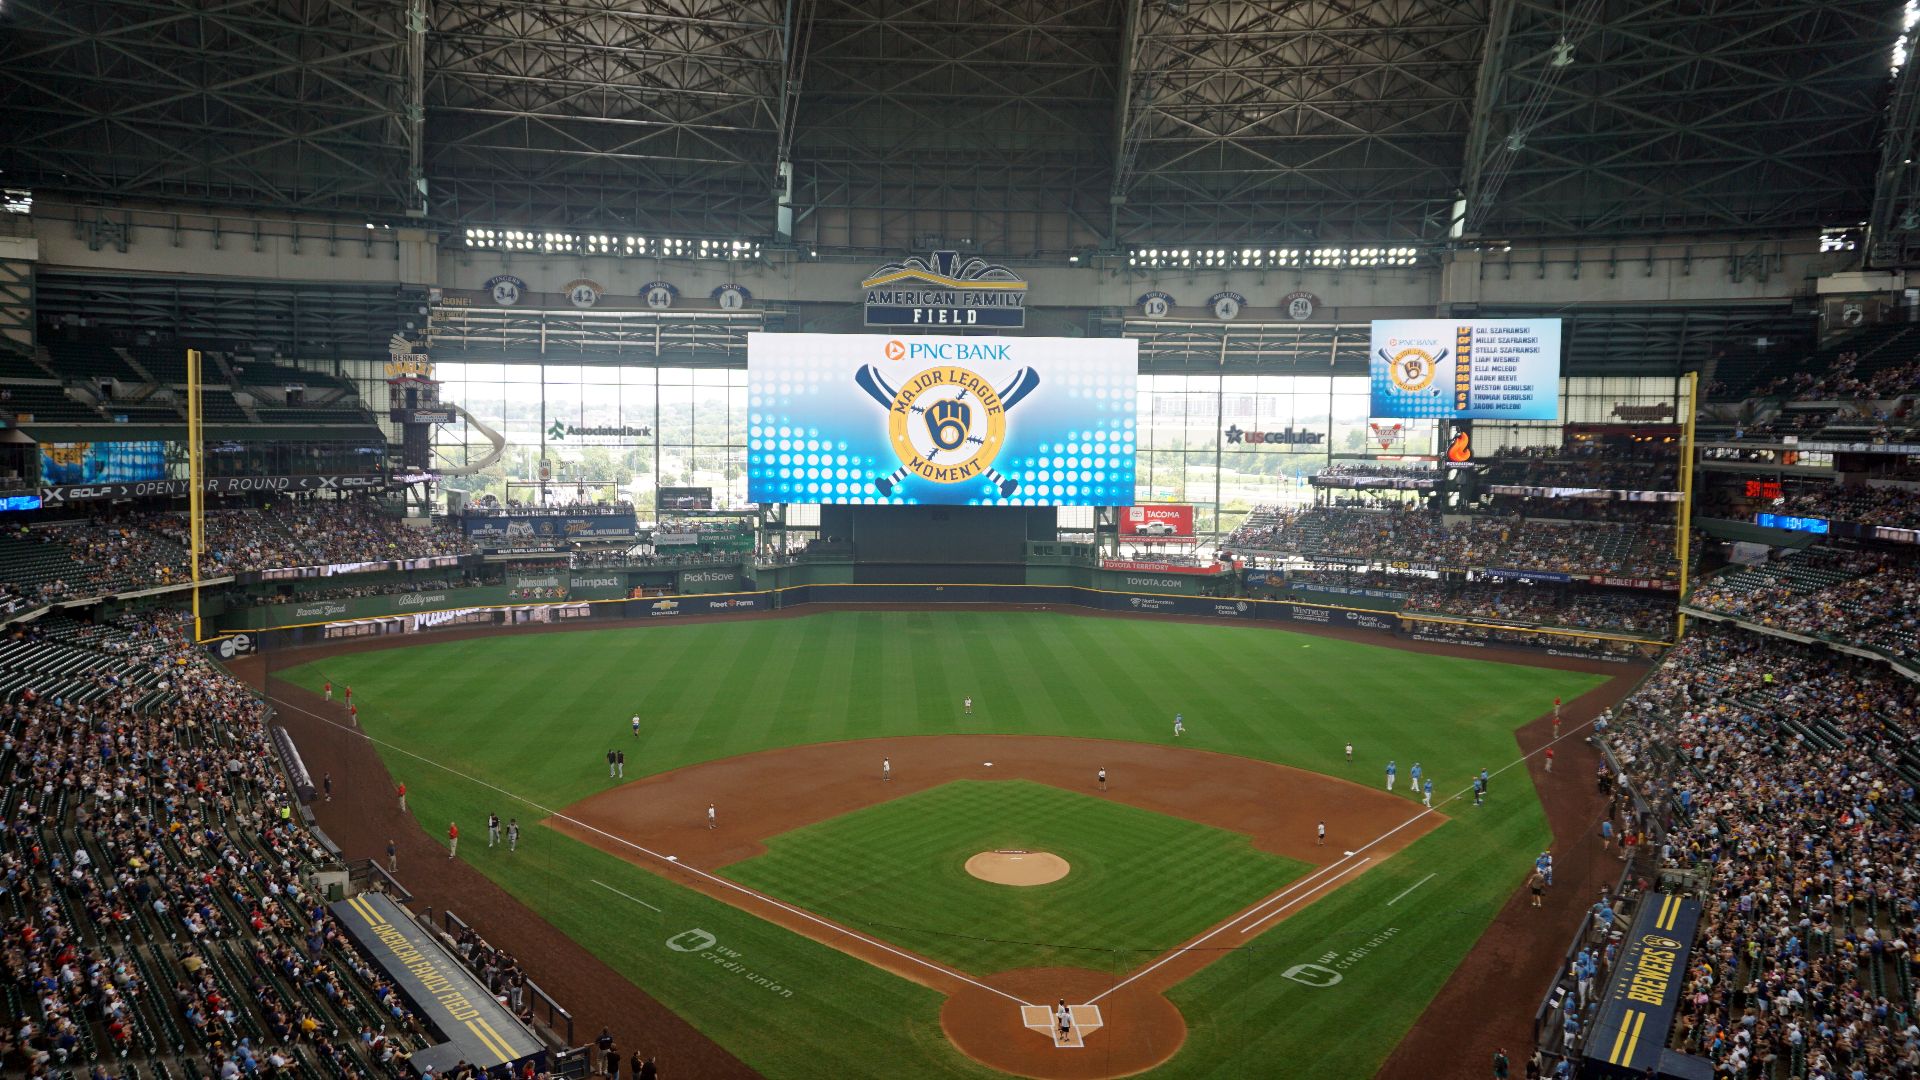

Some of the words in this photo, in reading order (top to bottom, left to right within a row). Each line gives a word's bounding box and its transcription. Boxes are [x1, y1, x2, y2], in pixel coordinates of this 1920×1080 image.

[496, 286, 516, 300] 34
[573, 289, 592, 302] 42
[866, 290, 956, 305] AMERICAN
[962, 292, 1024, 307] FAMILY
[442, 297, 472, 306] GONE!
[649, 293, 668, 306] 44
[1148, 302, 1165, 314] 19
[1221, 302, 1230, 314] 4
[913, 308, 977, 324] FIELD
[910, 342, 953, 360] PNC
[956, 343, 1012, 361] BANK
[893, 369, 944, 415] MAJOR
[949, 369, 1002, 416] LEAGUE
[566, 425, 627, 436] Associated
[627, 425, 652, 437] Bank
[1244, 427, 1325, 444] uscellular
[908, 455, 982, 481] MOMENT
[42, 487, 65, 502] X
[69, 486, 112, 498] GOLF
[135, 482, 175, 496] OPEN
[228, 477, 290, 491] ROUND
[318, 476, 339, 488] X
[342, 476, 383, 487] GOLF
[1146, 510, 1180, 518] TACOMA
[1132, 563, 1169, 571] TERRITORY
[1410, 562, 1437, 570] WTMJ
[517, 576, 559, 588] Johnsonville
[580, 576, 618, 588] impact
[684, 573, 703, 582] Pick
[712, 572, 734, 581] Save
[1126, 577, 1182, 588] TOYOTA.COM
[1605, 577, 1632, 587] NICOLET
[1635, 579, 1650, 588] LAW
[399, 594, 426, 606] Bally
[425, 595, 446, 603] SPORTS
[295, 608, 323, 617] Barrel
[323, 604, 347, 615] Yard
[1293, 606, 1330, 617] WINTRUST
[1358, 620, 1377, 628] Health
[716, 946, 742, 958] uw
[1336, 947, 1371, 969] credit
[1365, 927, 1400, 948] union
[1317, 951, 1339, 964] uw
[371, 923, 426, 969] AMERICAN
[411, 961, 456, 994] FAMILY
[437, 991, 480, 1021] FIELD
[701, 951, 746, 974] credit
[745, 972, 793, 998] union
[1627, 947, 1676, 1006] BREWERS
